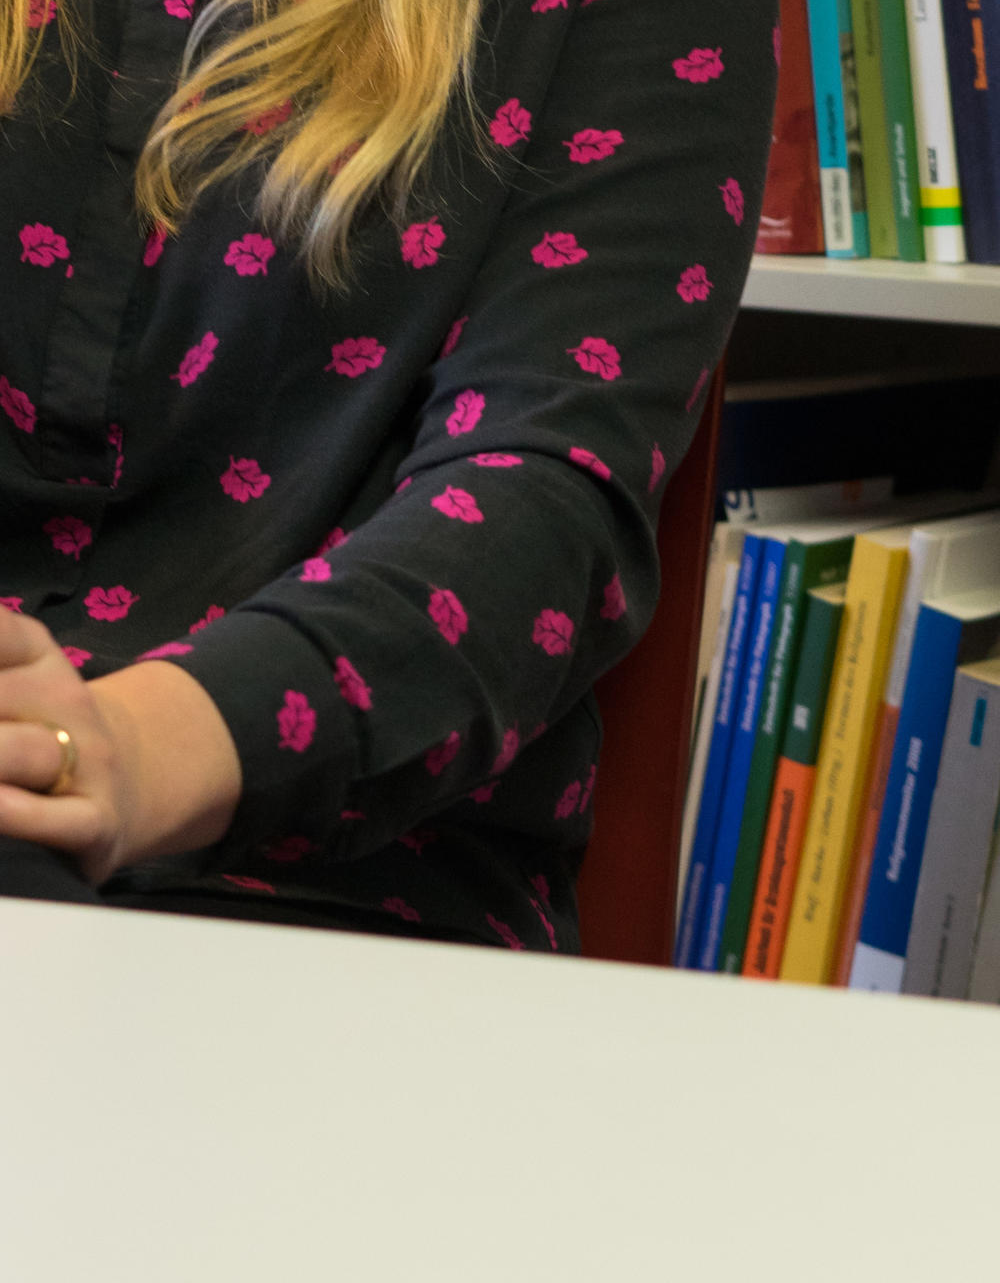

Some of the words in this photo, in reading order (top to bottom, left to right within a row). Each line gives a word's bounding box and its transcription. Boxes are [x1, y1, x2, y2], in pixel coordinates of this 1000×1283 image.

[895, 157, 907, 180] und
[717, 671, 735, 725] Zeitschrift
[731, 595, 747, 651] Pädagogik
[741, 677, 759, 733] Zeitschrift
[753, 601, 773, 657] Pädagogik
[763, 679, 781, 733] Zeitschrift
[775, 603, 793, 661] Pädagogik
[887, 775, 917, 881] Religionsmonitor
